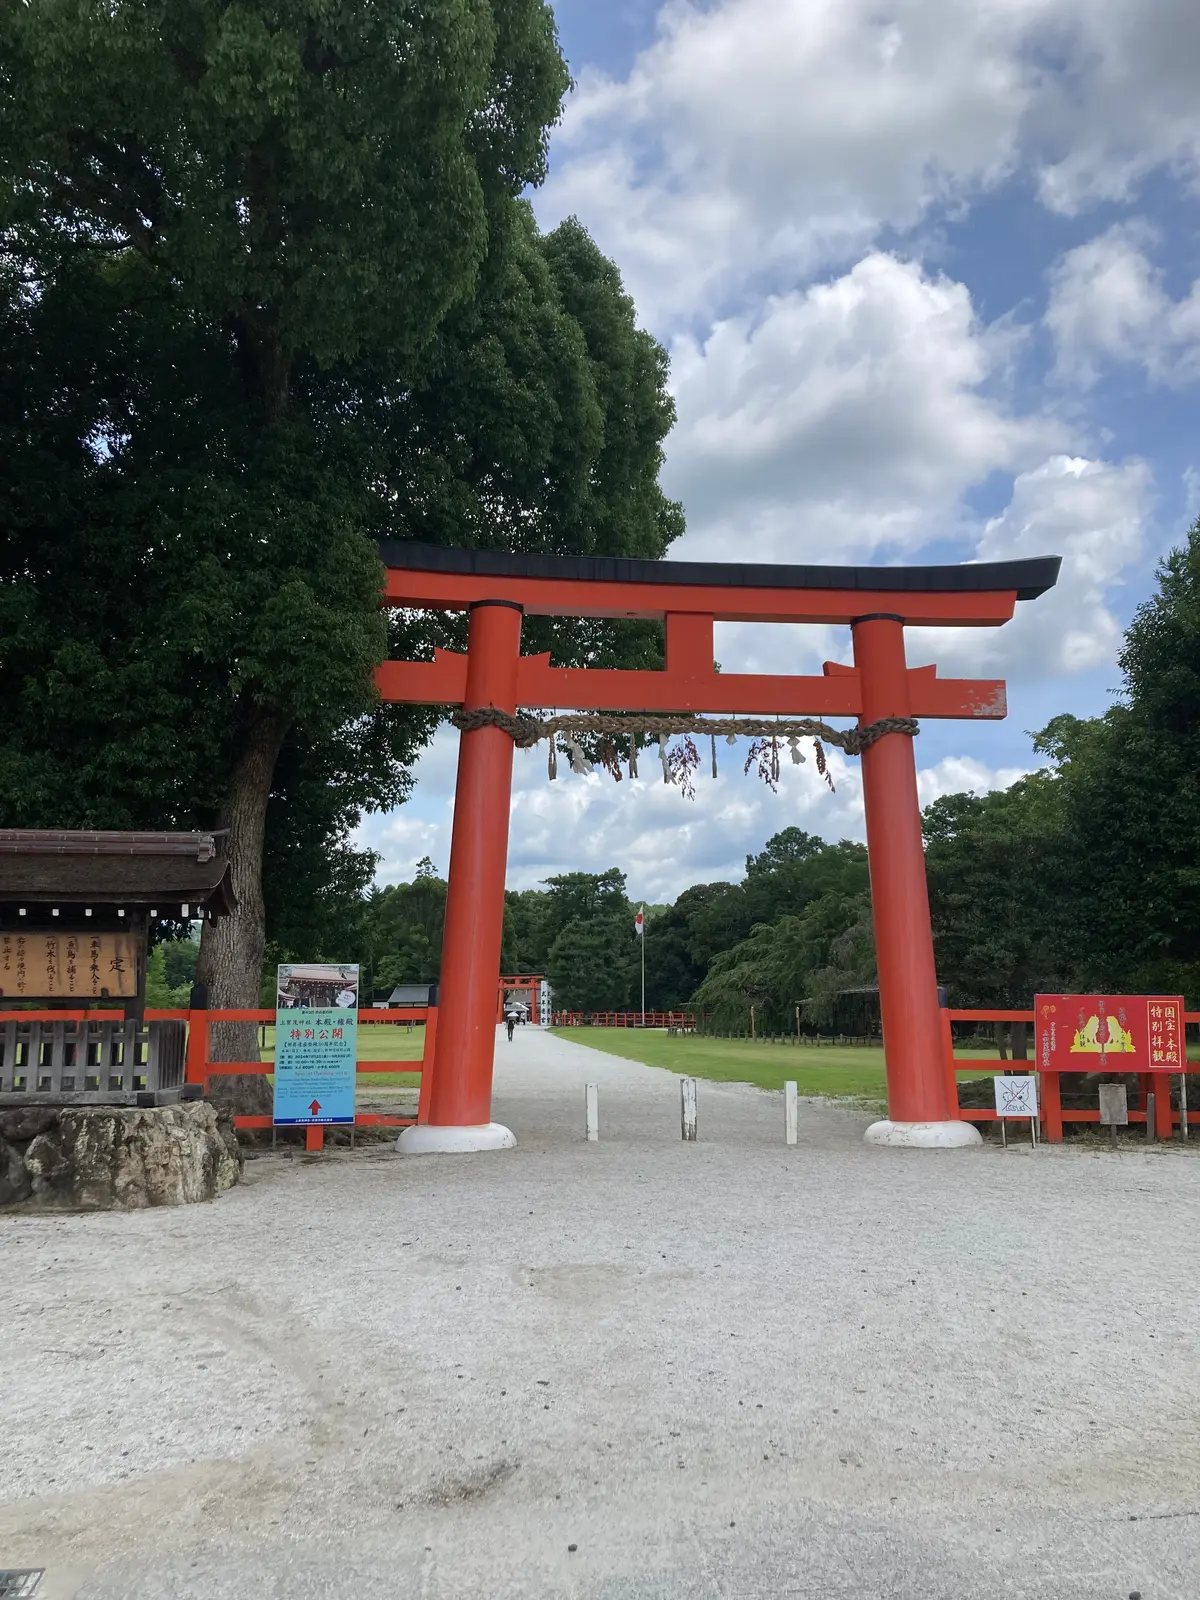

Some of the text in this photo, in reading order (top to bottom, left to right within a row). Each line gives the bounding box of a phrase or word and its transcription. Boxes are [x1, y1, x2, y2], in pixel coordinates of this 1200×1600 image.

[109, 957, 125, 973] 定
[290, 1027, 343, 1040] 特別公開
[1150, 1006, 1166, 1062] 特別拝観
[1164, 1007, 1178, 1063] 国宝・本殿
